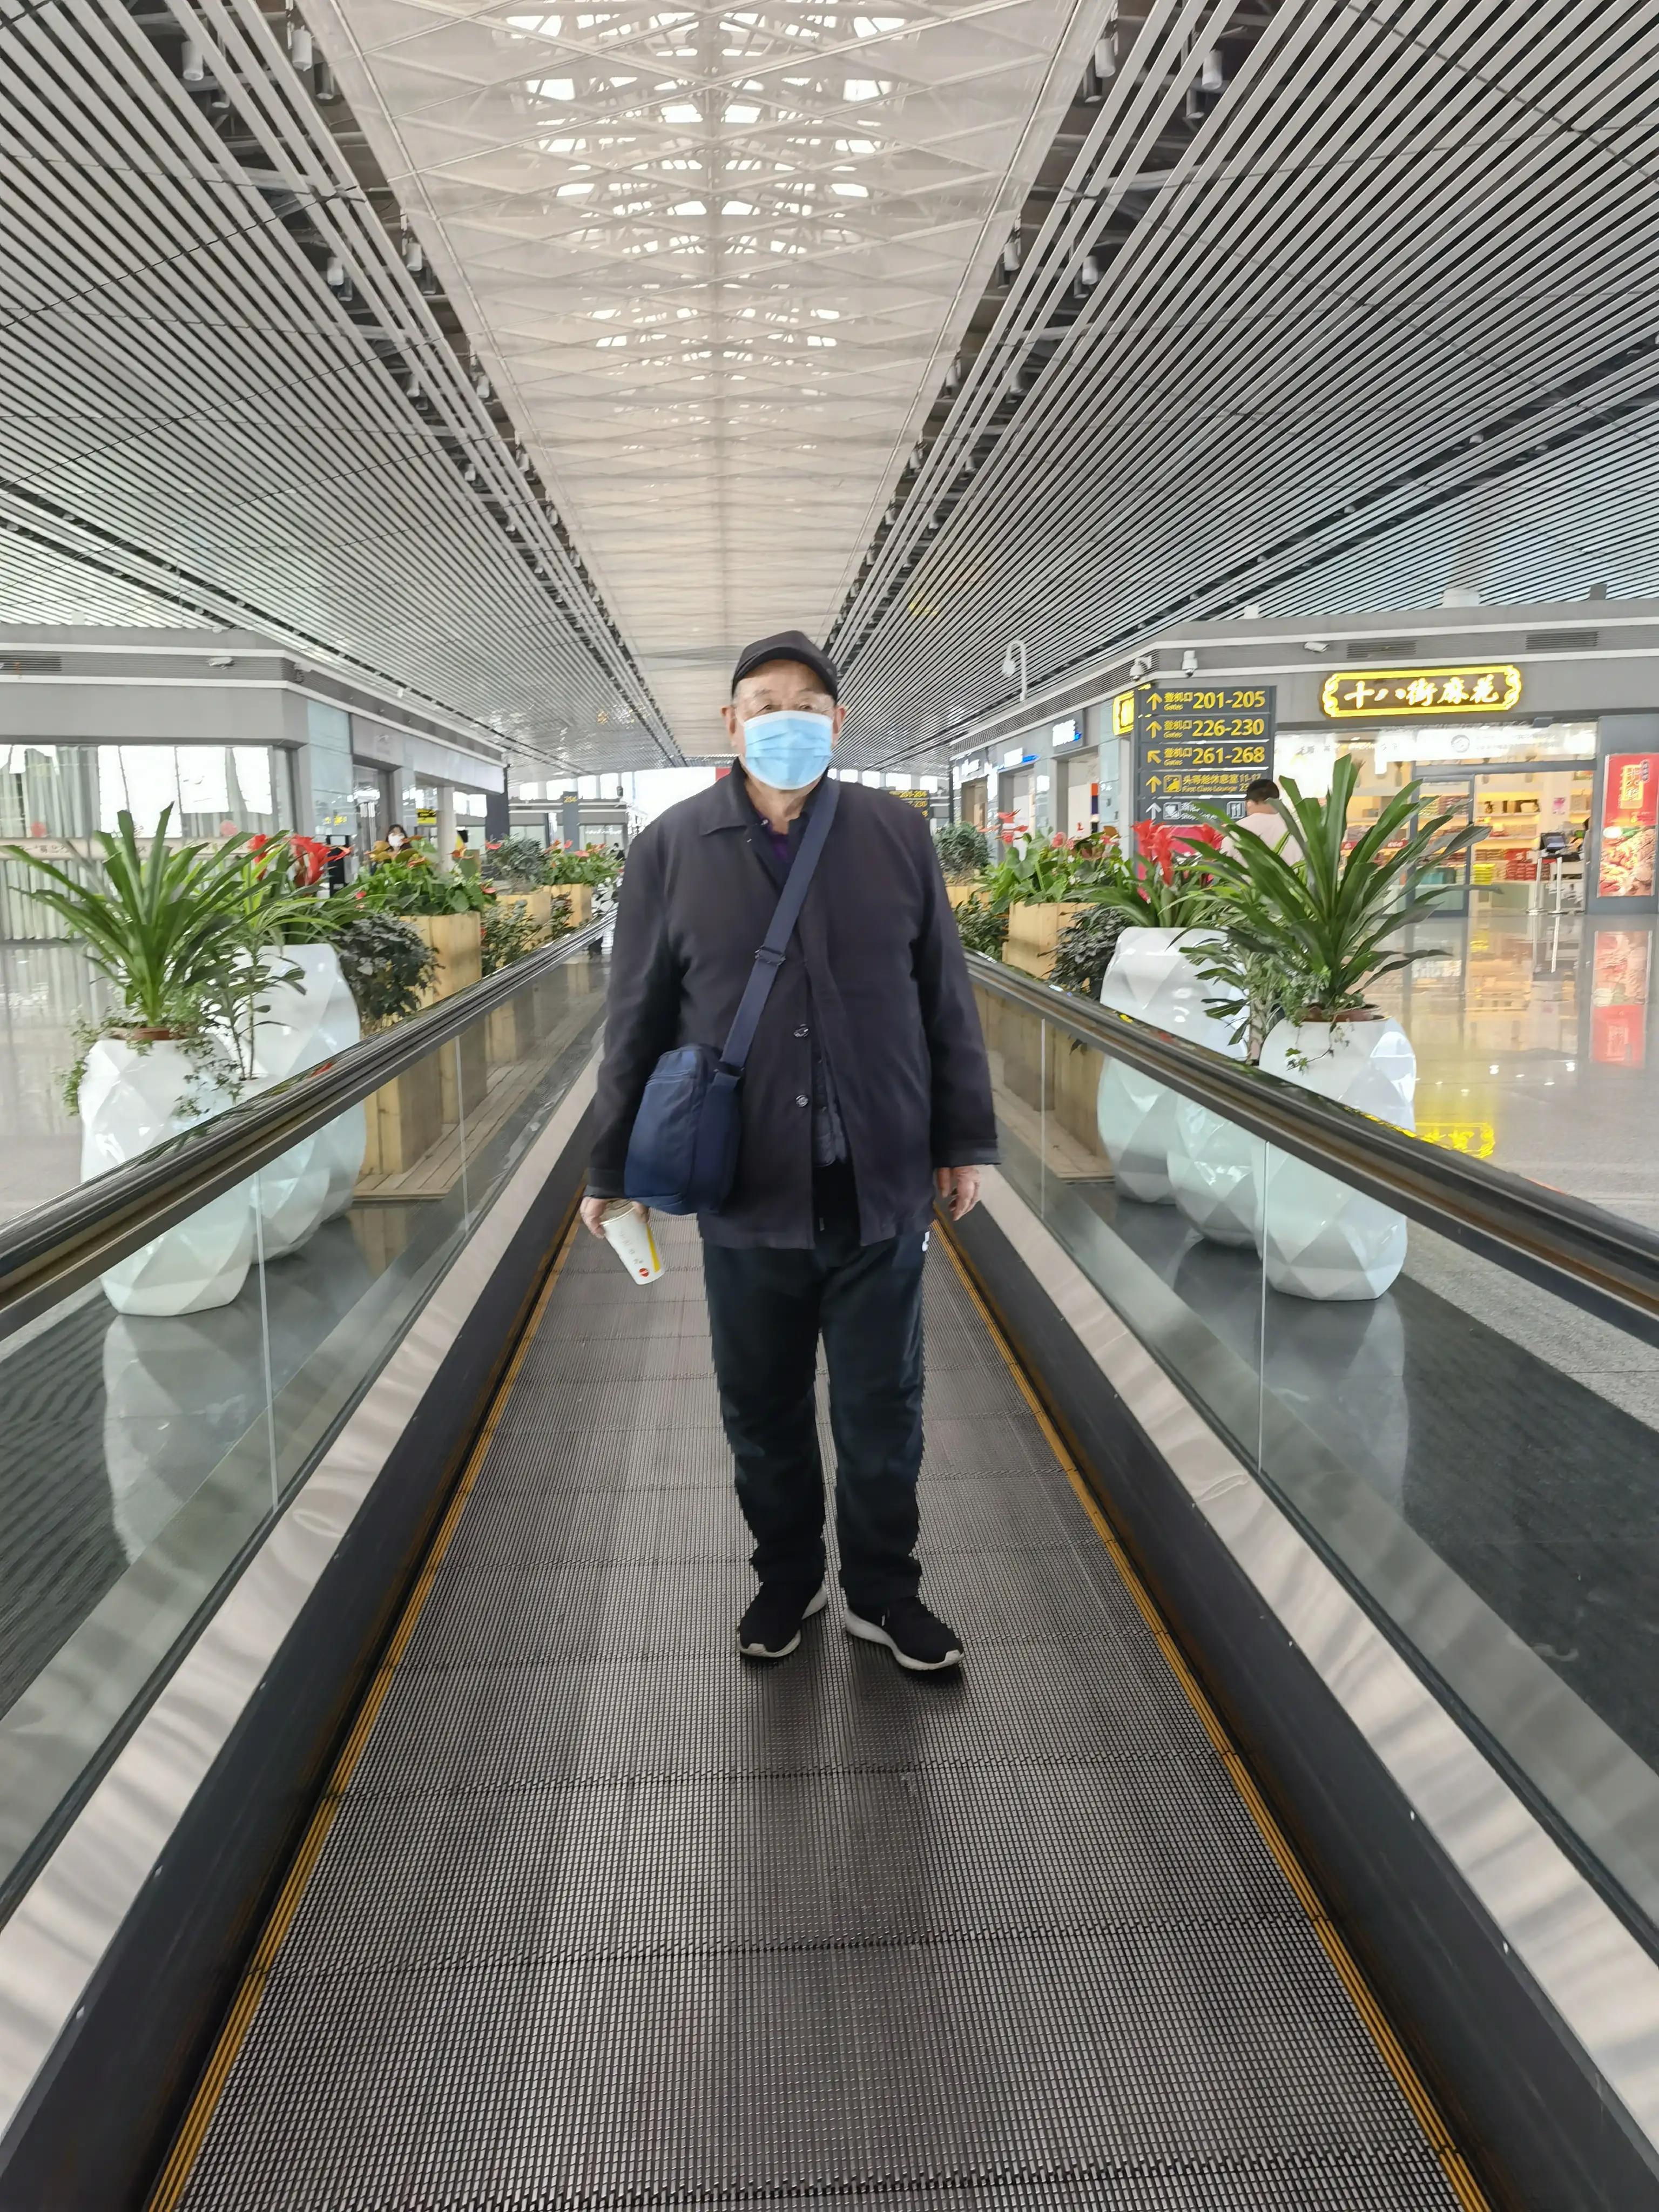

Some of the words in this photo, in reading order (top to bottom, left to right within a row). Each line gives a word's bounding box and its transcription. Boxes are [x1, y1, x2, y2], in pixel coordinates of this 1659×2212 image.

[1164, 692, 1193, 702] 登机口
[1192, 691, 1265, 709] 201-205
[1344, 673, 1500, 710] 十八街麻花
[1164, 720, 1192, 730] 登机口
[1192, 719, 1264, 737] 226-230
[1164, 747, 1192, 758] 登机口
[1192, 746, 1265, 765] 261-268
